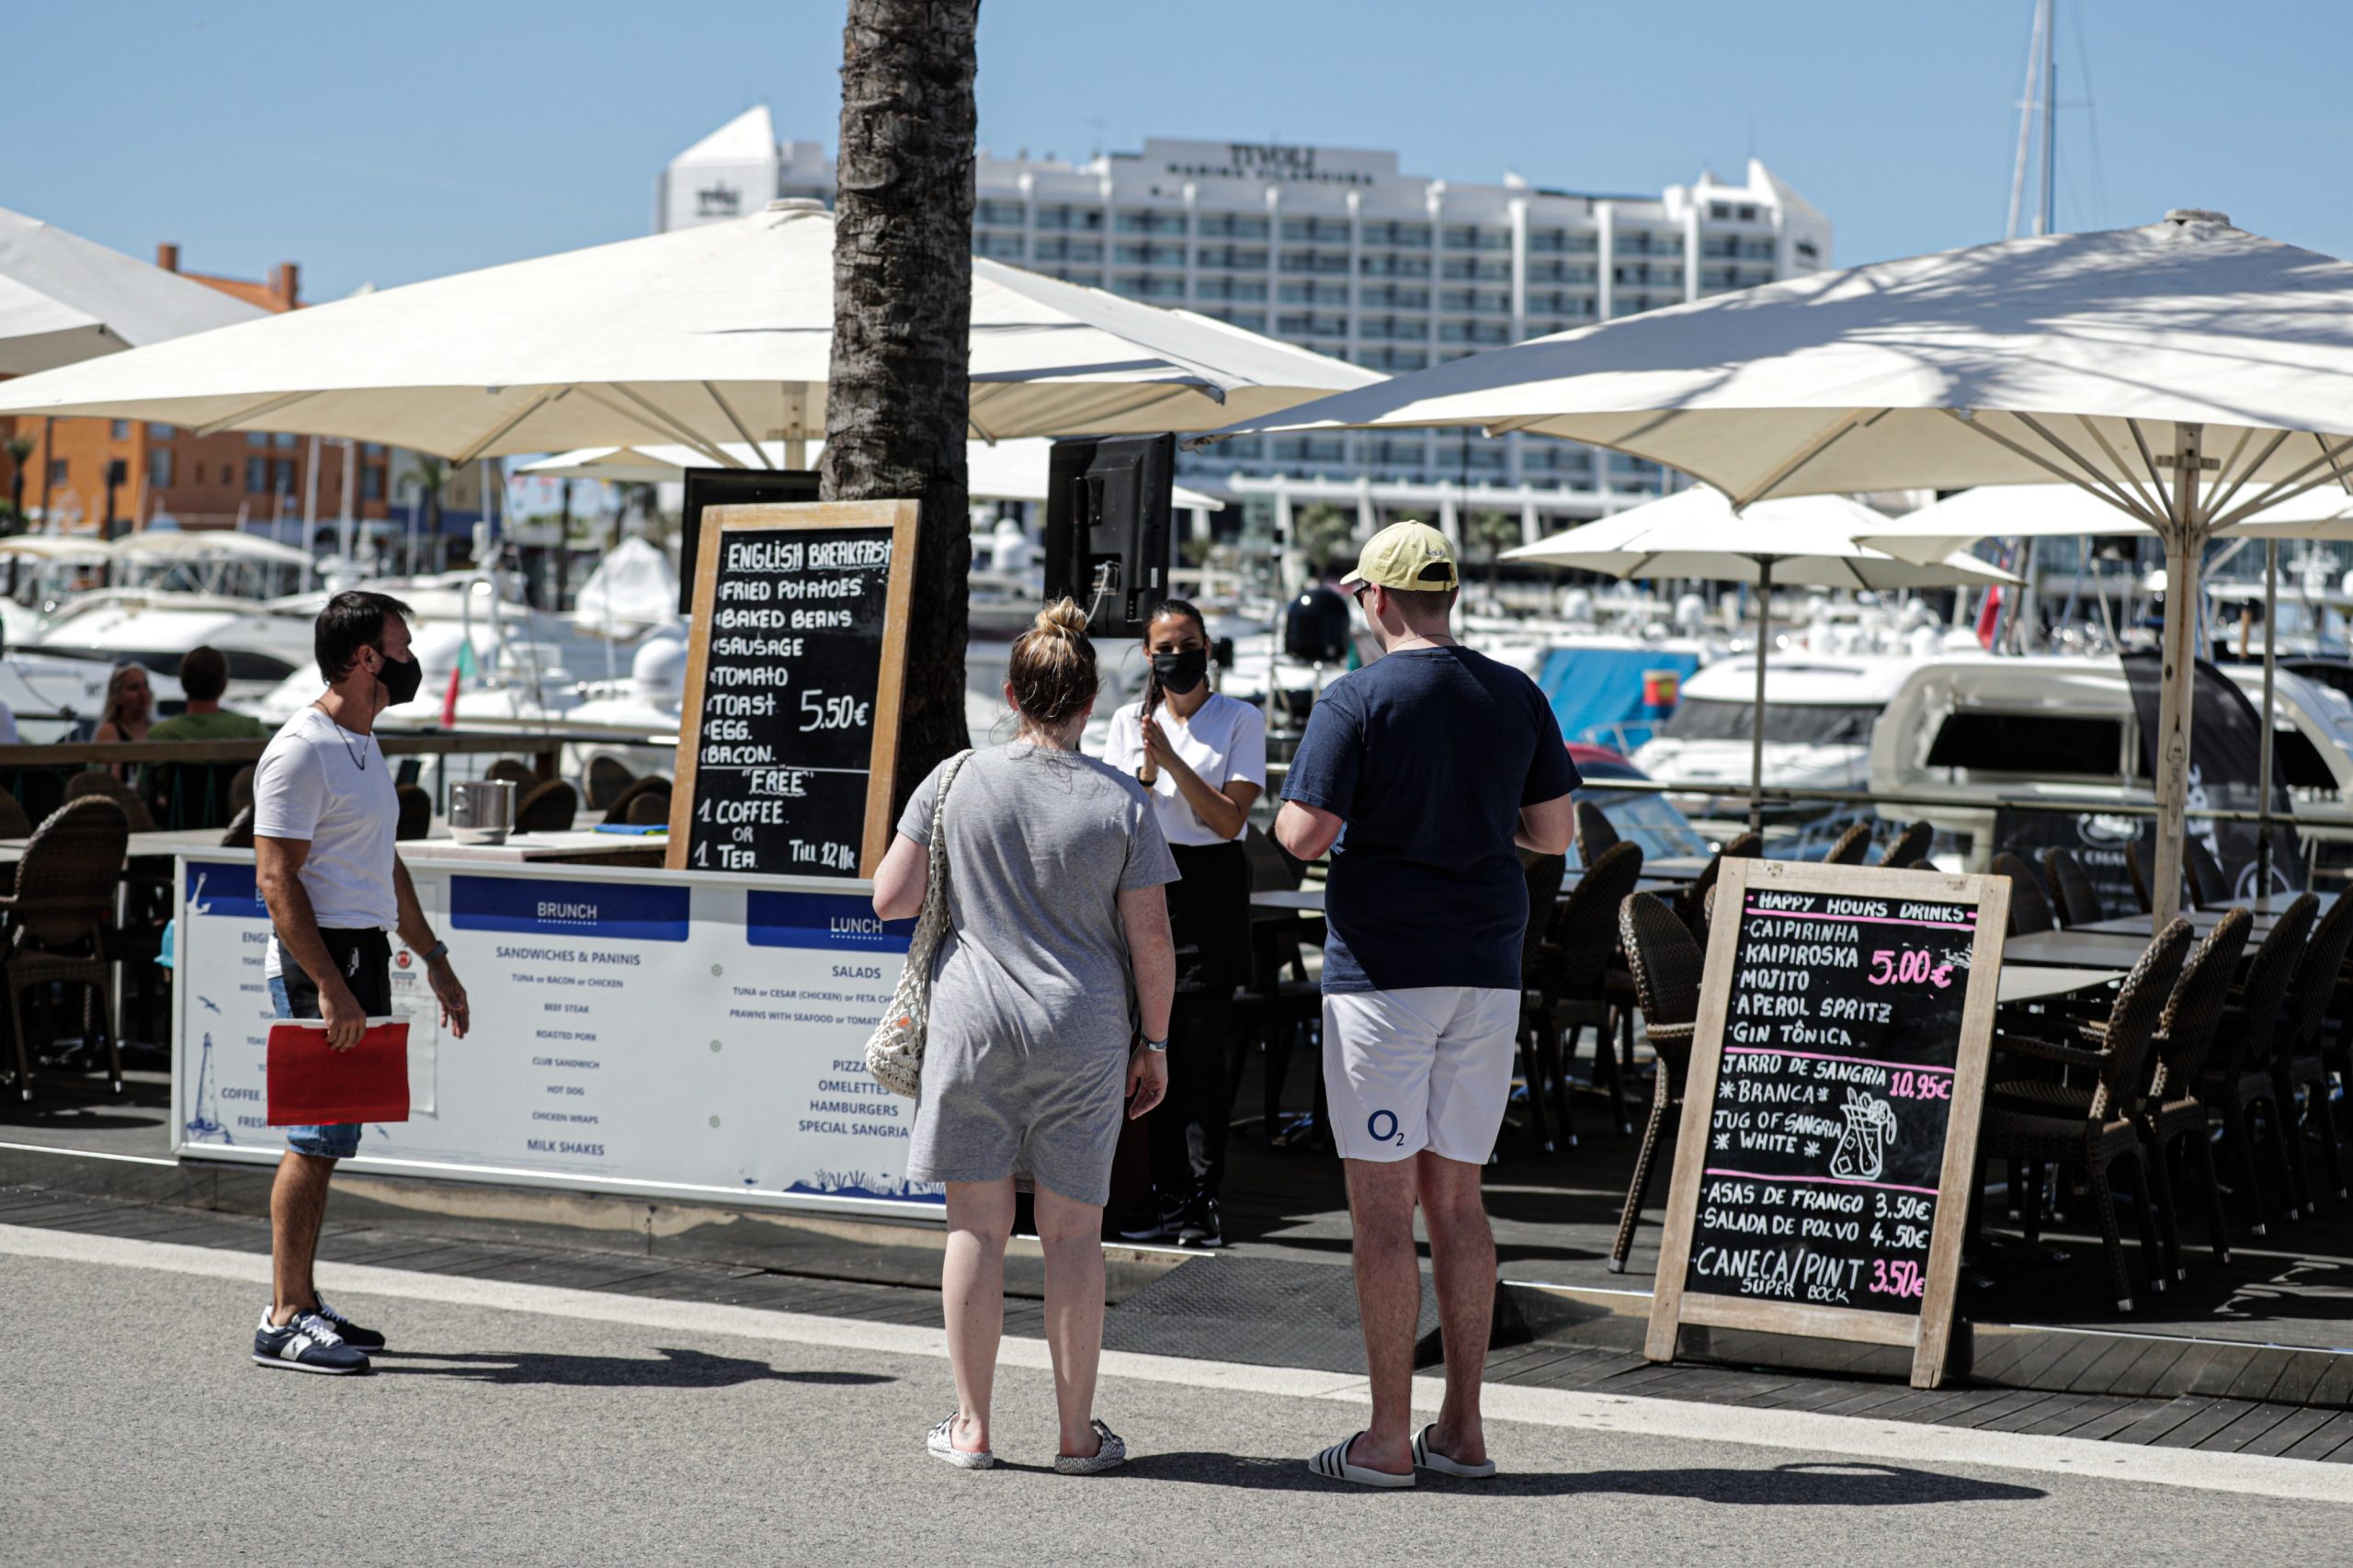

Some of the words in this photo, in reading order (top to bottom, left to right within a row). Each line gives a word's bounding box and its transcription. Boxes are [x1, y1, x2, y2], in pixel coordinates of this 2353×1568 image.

[722, 608, 785, 629] BAKED
[790, 609, 853, 629] BEANS
[719, 636, 804, 656] SAUSAGE
[799, 689, 870, 732] 5.50€
[698, 799, 711, 823] 1
[732, 826, 754, 843] OR
[694, 841, 710, 867] 1
[538, 902, 597, 919] BRUNCH
[1758, 892, 1815, 912] HAPPY
[1826, 899, 1889, 917] HOURS
[1899, 903, 1965, 923] DRINKS
[830, 917, 882, 934] LUNCH
[1749, 919, 1859, 943] CAIPIRINHA
[496, 946, 574, 962] SANDWICHES
[577, 951, 588, 963] &
[591, 952, 642, 966] PANINIS
[1745, 943, 1859, 968] KAIPIROSKA
[1868, 949, 1954, 988] 5.00€
[511, 973, 534, 983] TUNA
[547, 976, 575, 985] BACON
[587, 978, 624, 988] CHICKEN
[832, 965, 881, 979] SALADS
[1740, 969, 1810, 991] MOJITO
[733, 986, 756, 996] TUNA
[769, 989, 796, 999] CESAR
[799, 990, 842, 1002] (CHICKEN)
[856, 994, 876, 1004] FETA
[544, 1003, 563, 1012] BEEF
[564, 1004, 590, 1014] STEAK
[730, 1009, 766, 1019] PRAWNS
[768, 1012, 791, 1021] WITH
[793, 1013, 834, 1024] SEAFOOD
[1736, 994, 1810, 1017] APEROL
[1820, 997, 1893, 1024] SPRITZ
[536, 1029, 573, 1040] ROASTED
[574, 1032, 597, 1041] PORK
[1733, 1021, 1770, 1043] GIN
[1780, 1019, 1852, 1046] TÔNICA
[532, 1057, 552, 1066] CLUB
[554, 1058, 600, 1069] SANDWICH
[1722, 1054, 1782, 1074] JARRO
[1788, 1058, 1811, 1076] DE
[1889, 1070, 1953, 1100] 10.95€
[221, 1087, 260, 1101] COFFEE
[546, 1085, 563, 1094] HOT
[565, 1086, 585, 1096] DOG
[532, 1111, 567, 1121] CHICKEN
[569, 1114, 598, 1124] WRAPS
[810, 1099, 899, 1117] HAMBURGERS
[799, 1119, 847, 1135] SPECIAL
[851, 1123, 909, 1139] SANGRIA
[1713, 1109, 1750, 1130] JUG
[1757, 1111, 1783, 1129] OF
[1784, 1113, 1843, 1139] SANGRIA
[527, 1139, 556, 1152] MILK
[559, 1142, 605, 1156] SHAKES
[1707, 1182, 1756, 1205] ASAS
[1761, 1186, 1786, 1206] DE
[1791, 1189, 1864, 1213] FRANGO
[1874, 1192, 1931, 1221] 3.50€
[1703, 1207, 1768, 1235] SALADA
[1772, 1214, 1795, 1234] DE
[1802, 1218, 1859, 1241] POLVO
[1870, 1221, 1929, 1249] 4.50€
[1868, 1258, 1926, 1298] 3.50€
[1740, 1278, 1795, 1298] SUPER
[1807, 1285, 1849, 1303] BOCK
